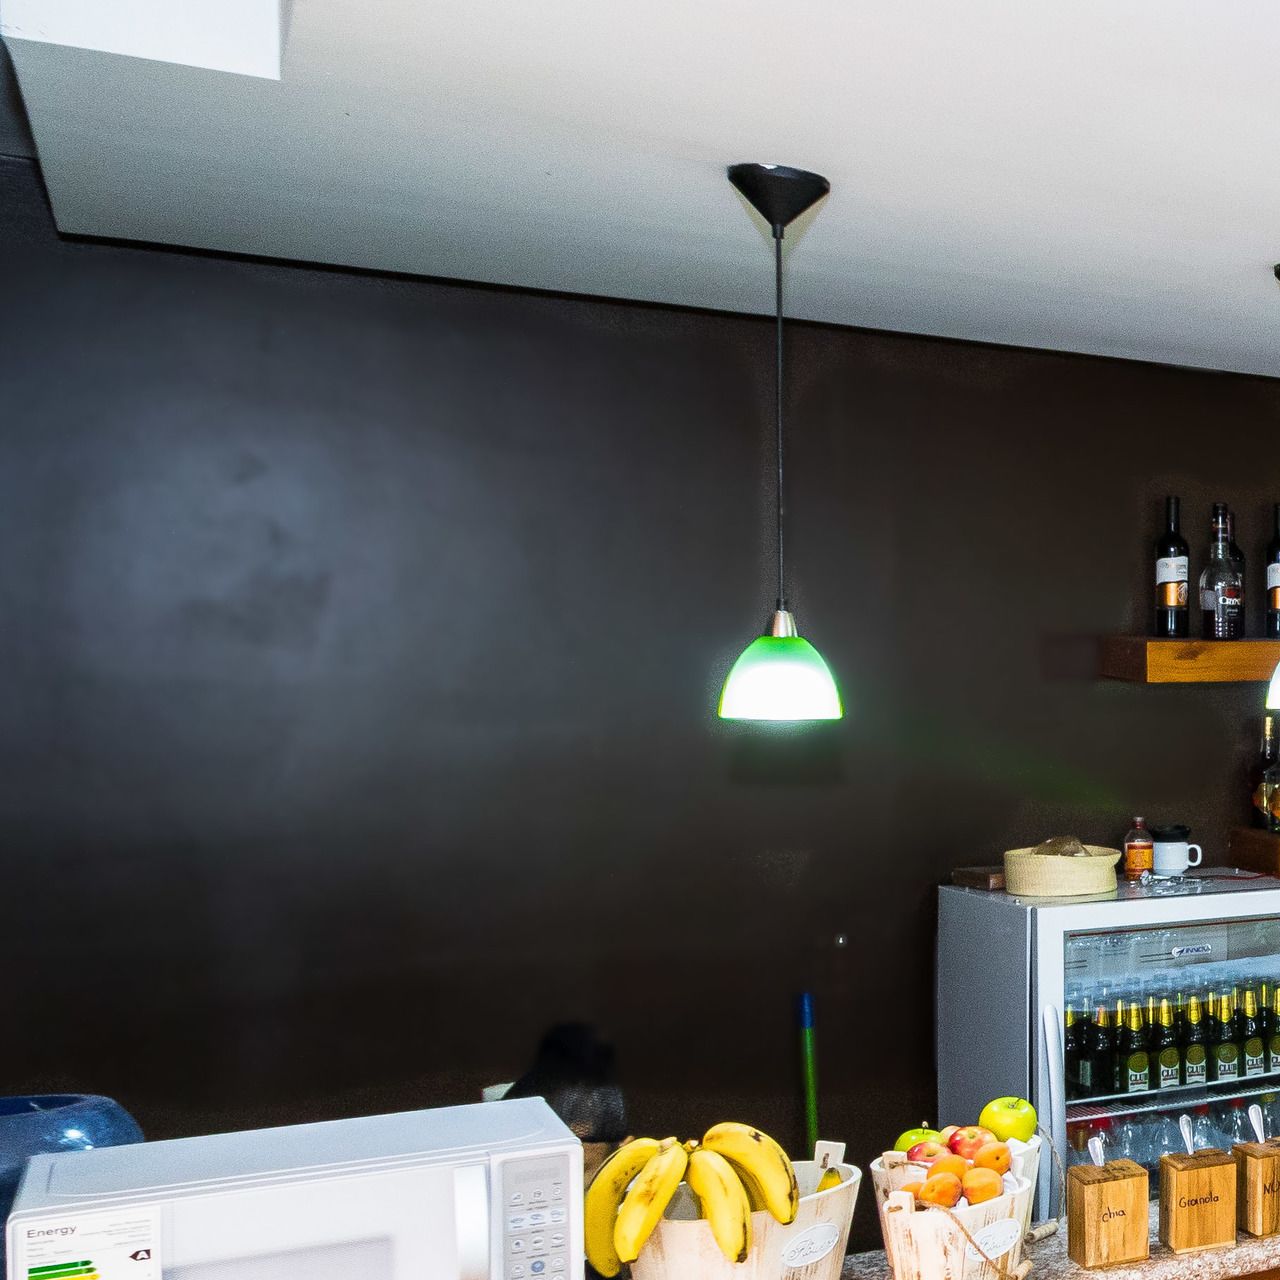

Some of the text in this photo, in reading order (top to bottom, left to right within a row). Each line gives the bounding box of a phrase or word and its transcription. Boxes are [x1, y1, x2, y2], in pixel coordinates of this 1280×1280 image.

[1187, 1065, 1206, 1074] CLUB
[1178, 1191, 1220, 1209] Granola
[26, 1225, 77, 1239] Energy
[135, 1249, 150, 1261] A
